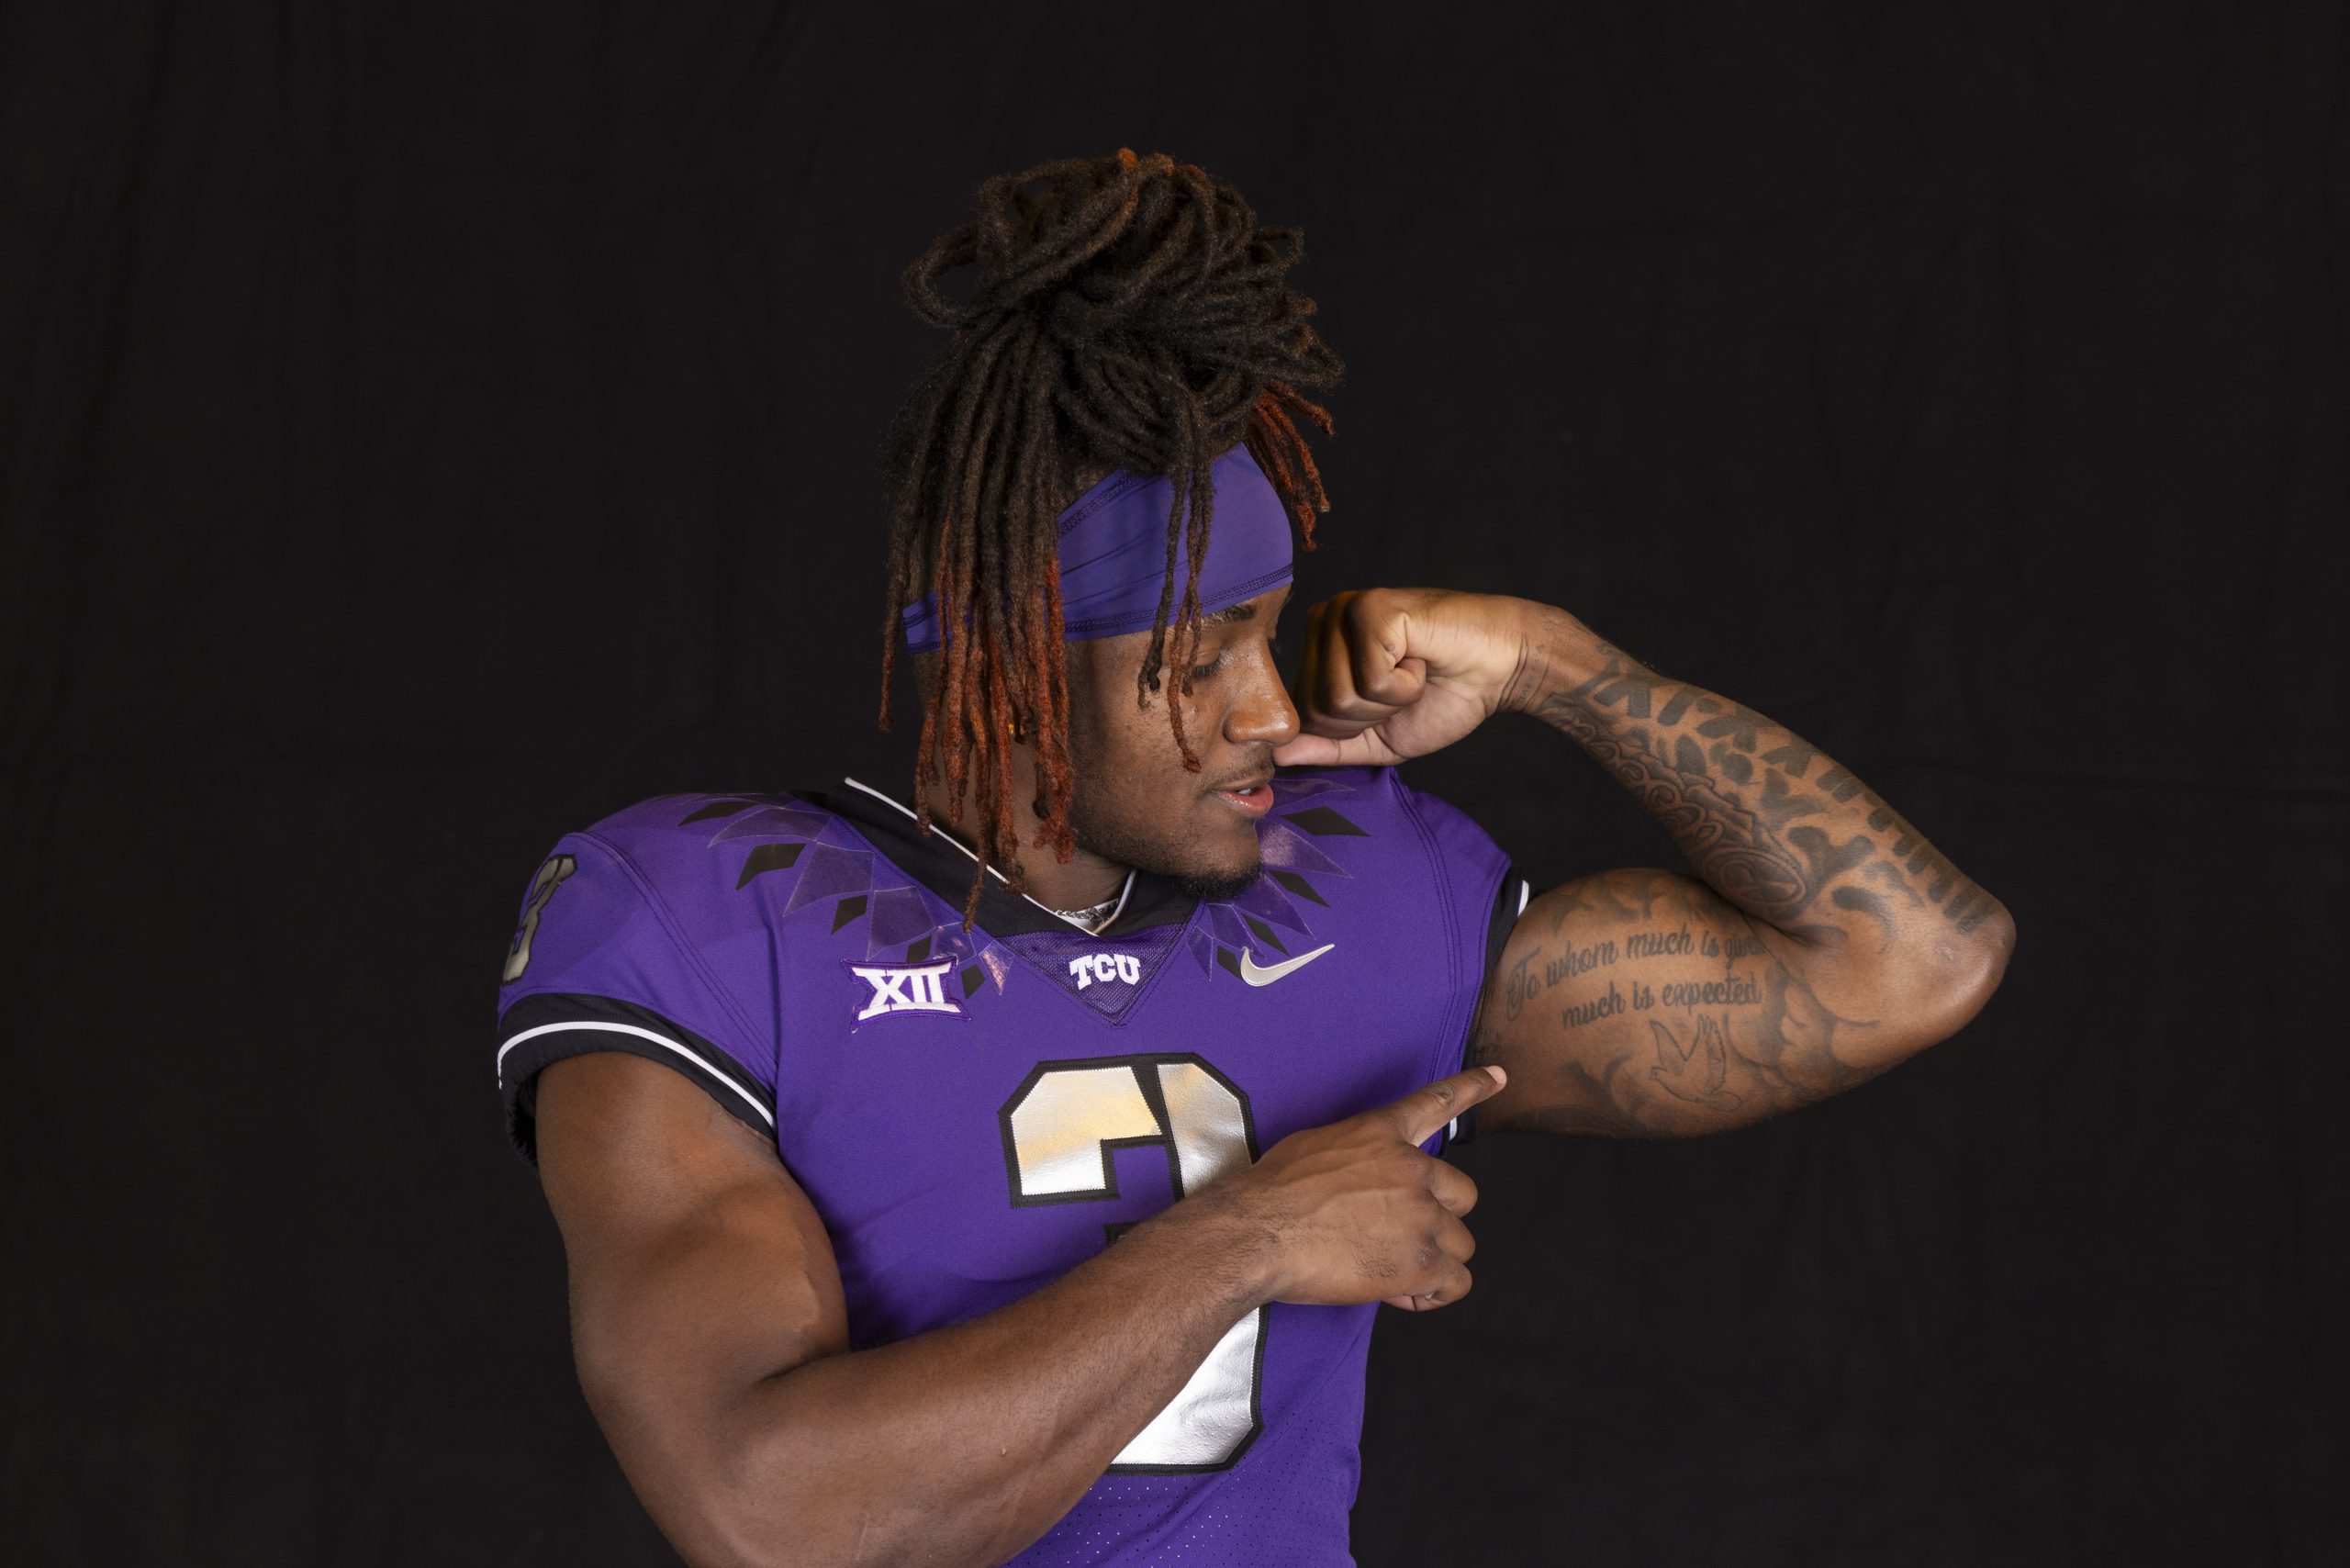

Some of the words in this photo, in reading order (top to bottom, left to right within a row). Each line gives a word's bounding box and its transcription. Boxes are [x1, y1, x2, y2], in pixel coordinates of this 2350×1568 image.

[503, 853, 577, 987] 3
[852, 964, 962, 1022] XII
[1069, 953, 1141, 991] TCU
[1506, 945, 1542, 1022] To
[1546, 939, 1619, 988] whom
[1626, 922, 1696, 959] much
[1700, 929, 1719, 958] is
[1561, 980, 1627, 1031] much
[1632, 980, 1655, 1011] is
[1662, 969, 1762, 1014] expected
